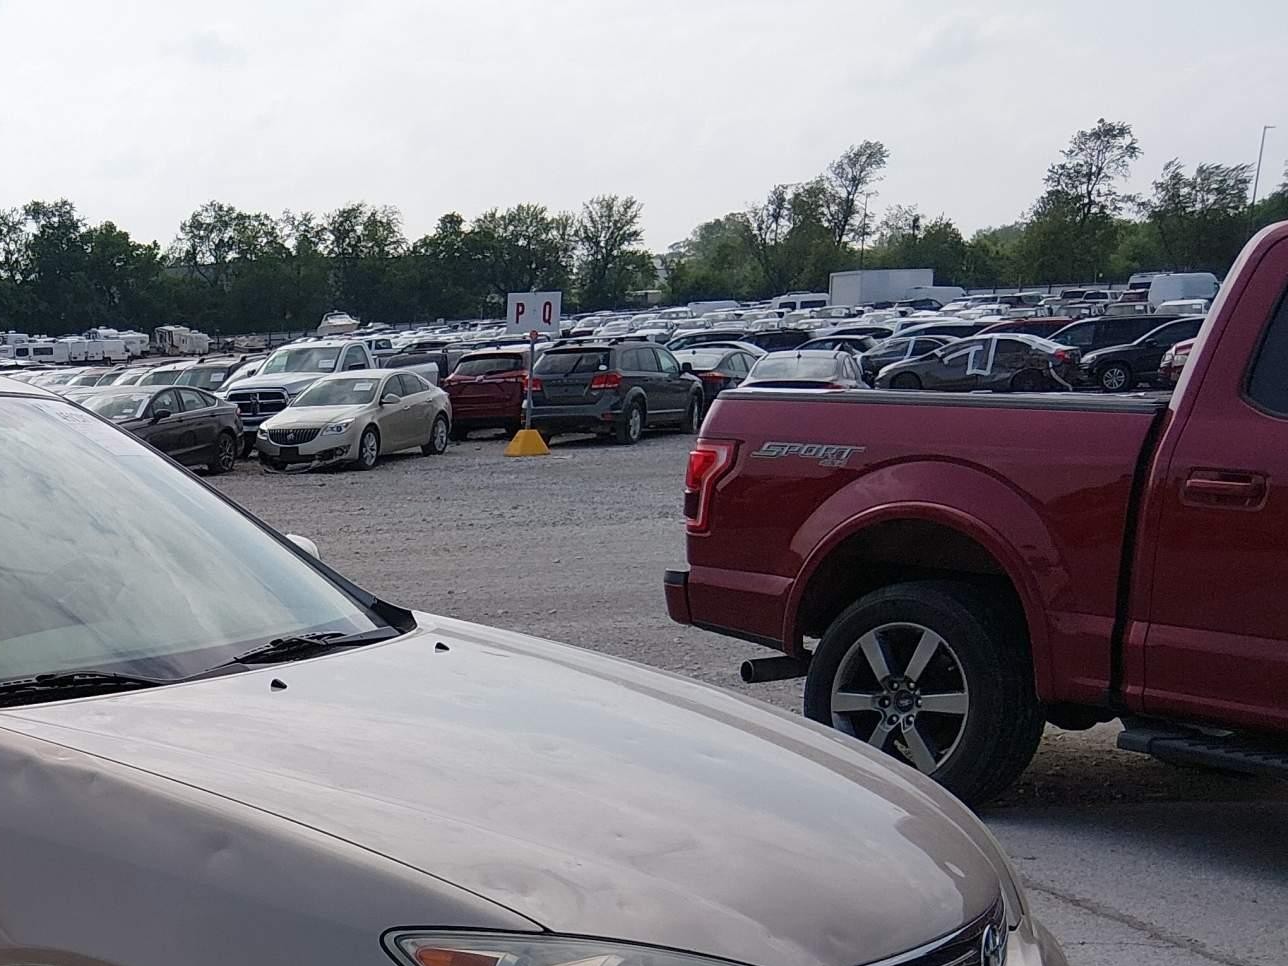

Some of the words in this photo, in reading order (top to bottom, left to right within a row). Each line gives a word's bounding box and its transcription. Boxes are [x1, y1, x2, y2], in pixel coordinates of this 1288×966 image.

[515, 302, 526, 325] P
[542, 300, 553, 326] Q
[749, 441, 867, 461] SPORT
